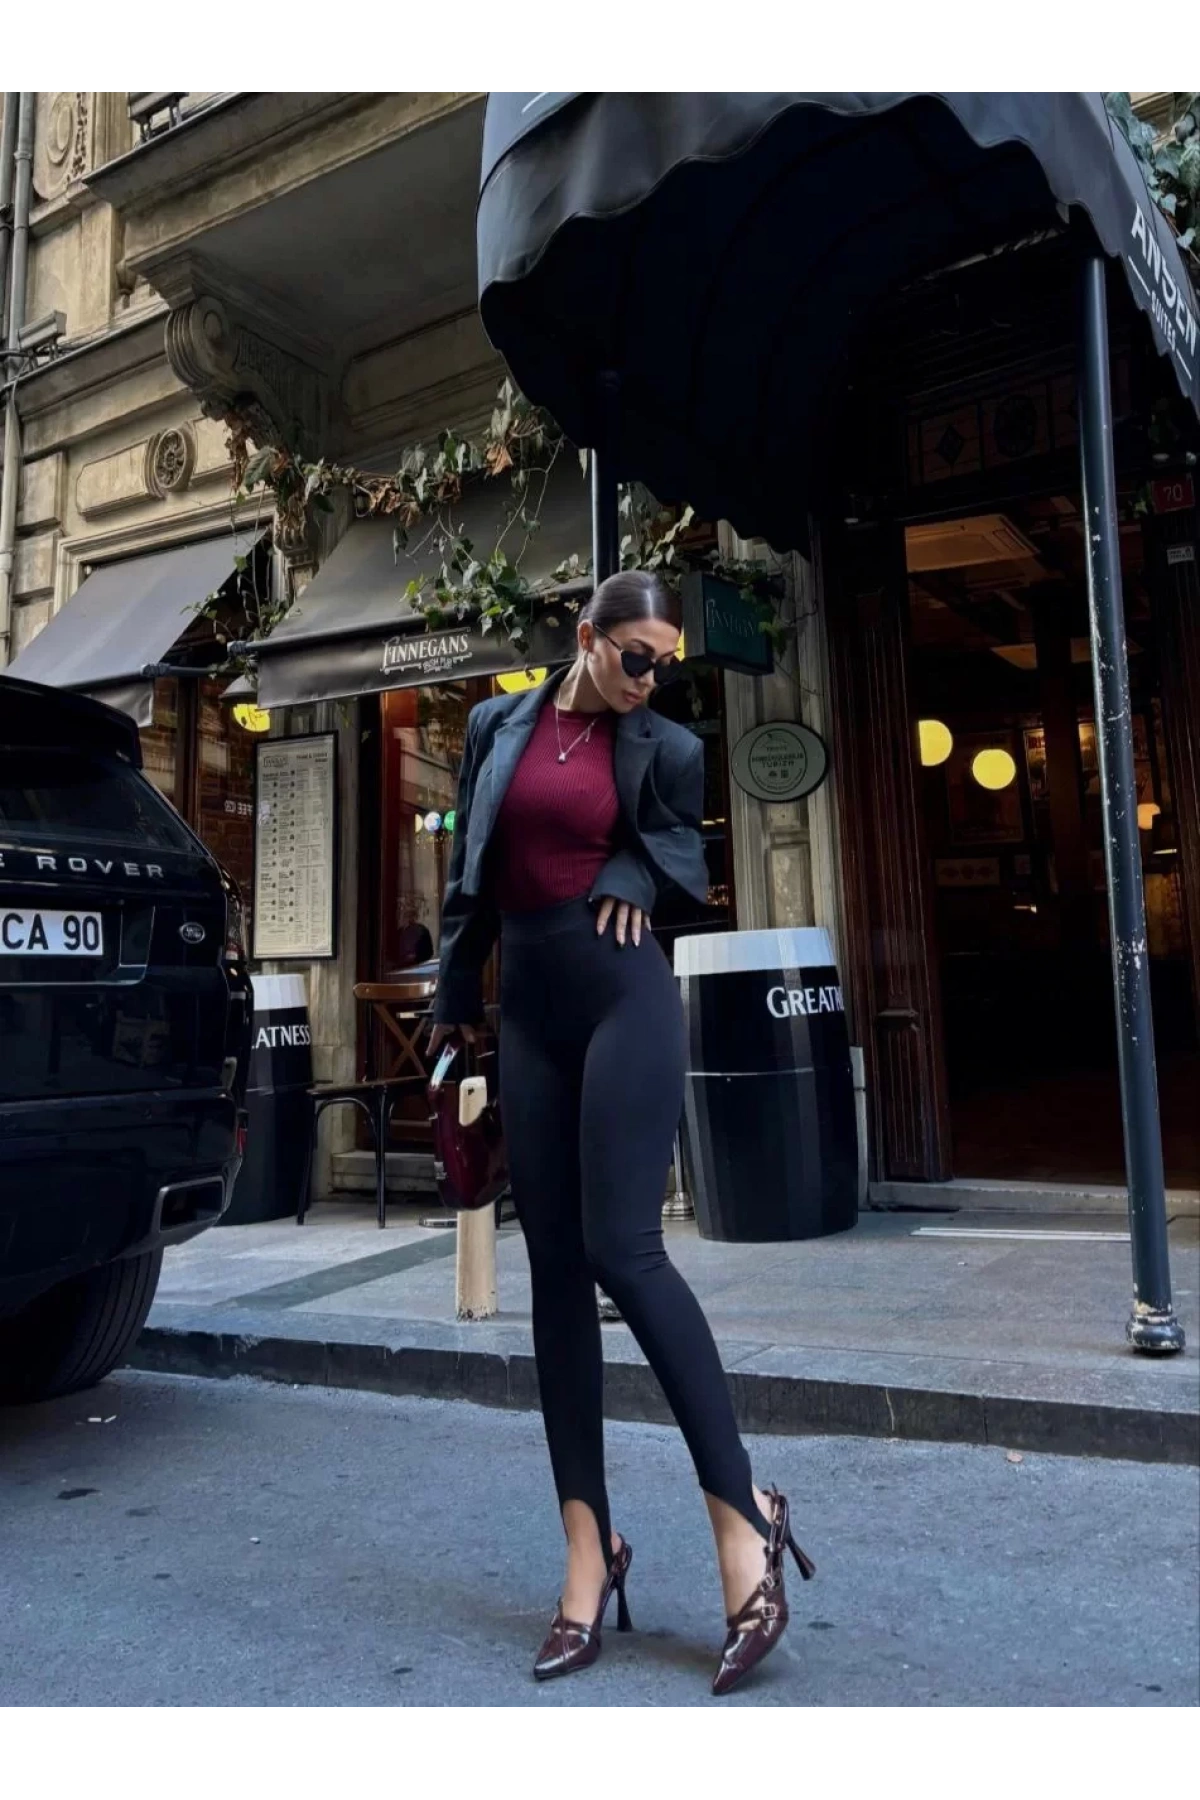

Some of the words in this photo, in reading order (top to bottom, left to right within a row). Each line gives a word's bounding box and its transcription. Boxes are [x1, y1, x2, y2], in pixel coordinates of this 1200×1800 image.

[1131, 201, 1196, 357] ANDEN
[1151, 290, 1176, 352] SUITES
[381, 635, 468, 671] FINNEGANS
[36, 855, 164, 878] ROVER
[2, 913, 49, 950] CA
[63, 914, 100, 951] 90
[251, 1024, 311, 1049] ATNESS
